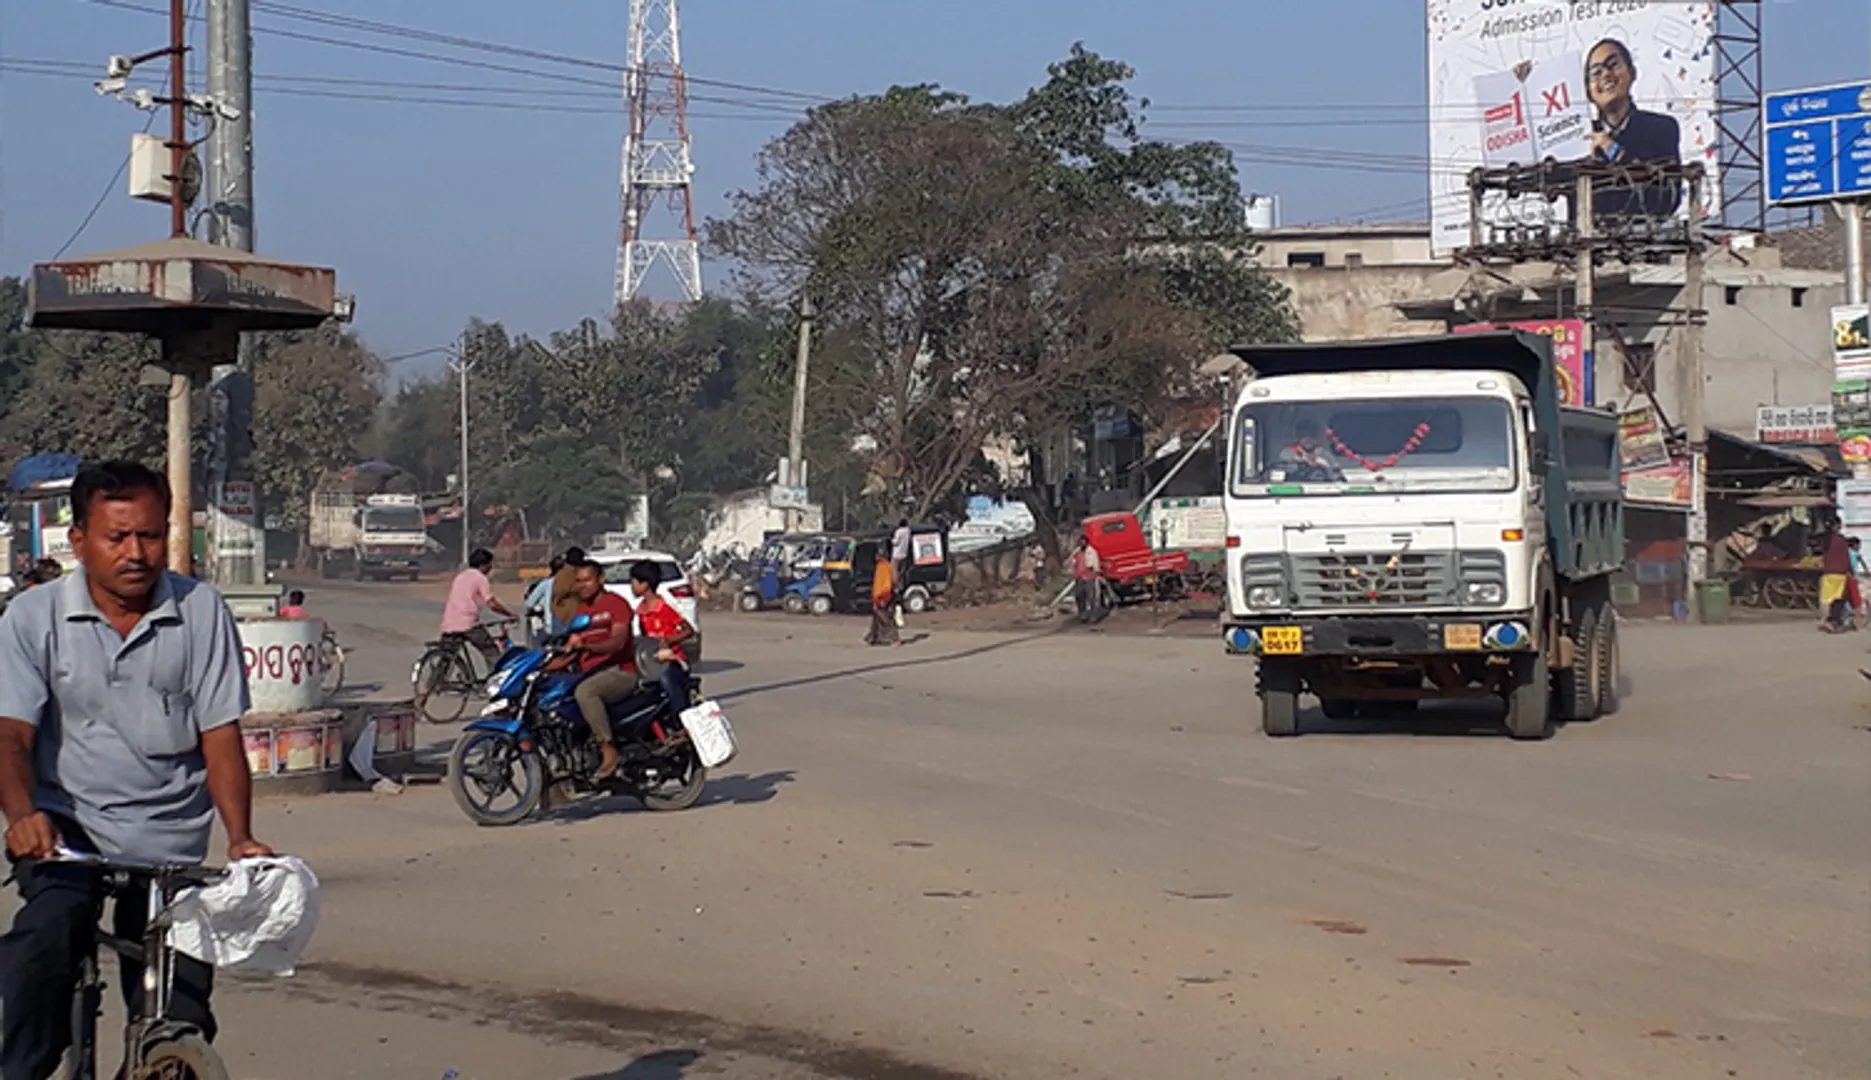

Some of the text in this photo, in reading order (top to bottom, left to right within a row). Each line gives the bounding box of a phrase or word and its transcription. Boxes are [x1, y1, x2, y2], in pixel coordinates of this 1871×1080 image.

[1480, 9, 1563, 39] Admission
[1569, 1, 1601, 21] Test
[1541, 82, 1570, 117] XI
[1486, 127, 1528, 152] ODISHA
[1537, 113, 1581, 138] Science
